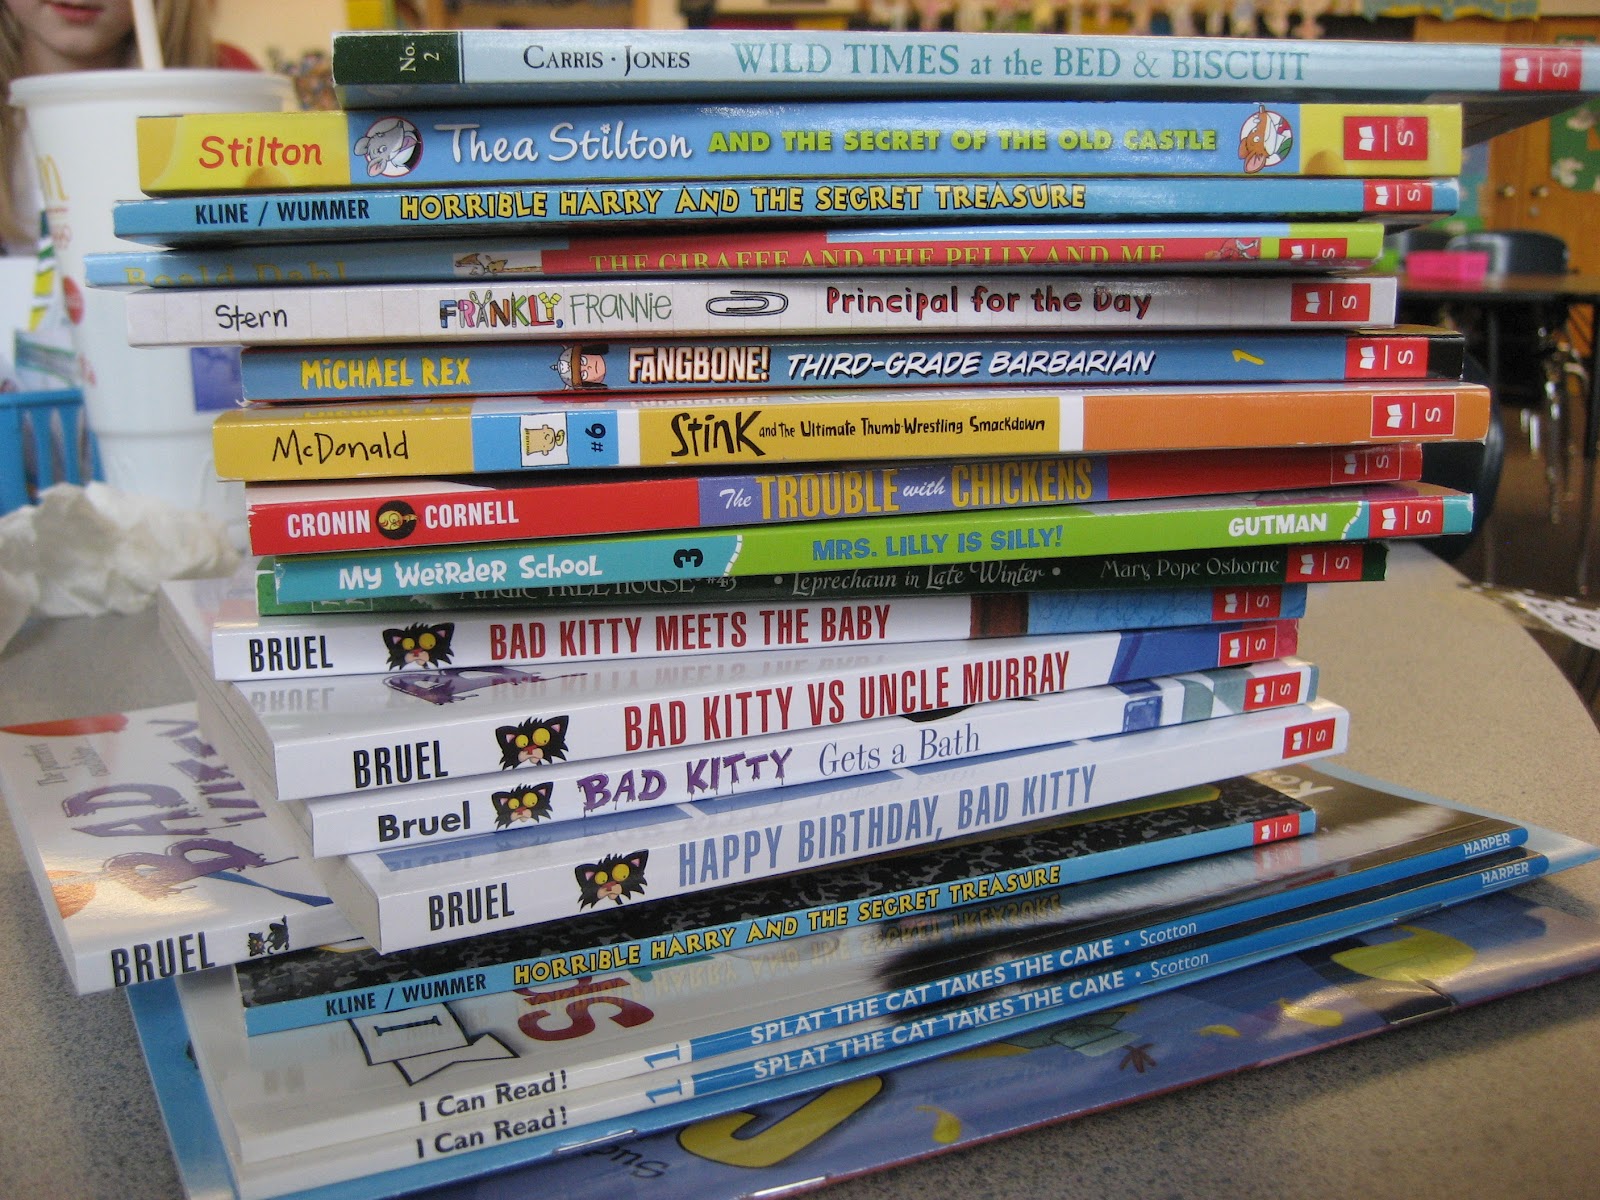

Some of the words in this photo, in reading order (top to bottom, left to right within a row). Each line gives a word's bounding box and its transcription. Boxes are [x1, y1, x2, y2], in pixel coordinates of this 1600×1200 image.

[400, 41, 417, 72] No.
[423, 51, 440, 62] 2
[731, 42, 832, 74] WILD
[844, 43, 960, 76] TIMES
[970, 54, 993, 76] at
[1003, 47, 1043, 77] the
[1053, 46, 1121, 79] BED
[1133, 51, 1161, 79] &
[1172, 48, 1310, 81] BISCUIT
[199, 135, 322, 169] Stilton
[433, 122, 539, 164] Thea
[548, 119, 693, 162] Stilton
[707, 130, 777, 154] AND
[780, 129, 838, 152] THE
[843, 129, 941, 152] SECRET
[950, 129, 988, 152] OF
[996, 129, 1047, 151] THE
[1057, 129, 1113, 151] OLD
[1122, 129, 1217, 152] CASTLE
[195, 201, 249, 226] KLINE
[277, 199, 370, 222] WUMMER
[401, 190, 548, 221] HORRIBLE
[558, 187, 663, 218] HARRY
[675, 185, 740, 217] AND
[751, 185, 803, 213] THE
[815, 182, 924, 213] SECRET
[934, 181, 1087, 210] TREASURE
[589, 254, 649, 272] THE
[657, 250, 790, 271] GIRAFFE
[801, 249, 865, 268] AND
[872, 247, 935, 266] THE
[1046, 245, 1111, 263] AND
[1120, 245, 1166, 262] ME
[215, 304, 289, 332] Stern
[826, 286, 960, 321] Principal
[971, 284, 1021, 313] for
[1030, 284, 1083, 312] the
[1093, 285, 1153, 320] Day
[421, 356, 472, 388] REX
[628, 345, 771, 383] FANGBONE!
[787, 351, 981, 381] THIRD-GRADE
[987, 350, 1157, 378] BARBARIAN
[585, 422, 608, 453] #6
[758, 422, 777, 438] and
[778, 421, 796, 438] The
[800, 420, 857, 438] Ultimate
[861, 416, 963, 437] Thumb-Wrestling
[272, 429, 410, 466] McDonald
[719, 487, 752, 510] The
[754, 467, 901, 521] TROUBLE
[902, 474, 947, 498] with
[950, 457, 1093, 508] CHICKENS
[287, 508, 372, 539] CRONIN
[423, 500, 521, 530] CORNELL
[1228, 512, 1328, 538] GUTMAN
[672, 547, 705, 570] 3
[812, 537, 878, 562] MRS.
[886, 532, 949, 558] LILLY
[958, 530, 983, 554] IS
[990, 524, 1064, 551] SILLY!
[339, 564, 383, 591] My
[792, 572, 898, 597] Leprechaun
[904, 570, 920, 588] in
[926, 565, 966, 591] Late
[970, 561, 1045, 587] Winter
[1100, 558, 1151, 581] Mary
[1156, 557, 1201, 580] Pope
[1206, 557, 1281, 576] Osborne
[490, 621, 548, 661] BAD
[559, 616, 643, 657] KITTY
[655, 610, 748, 653] MEETS
[762, 607, 810, 646] THE
[820, 604, 892, 642] BABY
[249, 635, 334, 673] BRUEL
[624, 702, 688, 751] BAD
[703, 685, 793, 741] KITTY
[807, 679, 846, 727] VS
[858, 666, 950, 720] UNCLE
[961, 650, 1070, 705] MURRAY
[353, 740, 449, 789] BRUEL
[576, 769, 668, 815] BAD
[686, 747, 794, 796] KITTY
[818, 741, 882, 777] Gets
[891, 744, 908, 765] a
[918, 722, 982, 762] Bath
[378, 800, 472, 843] Bruel
[678, 825, 783, 888] HAPPY
[798, 794, 943, 863] BIRTHDAY,
[957, 783, 1010, 830] BAD
[1021, 764, 1098, 817] KITTY
[1463, 832, 1511, 856] HARPER
[1480, 861, 1530, 885] HARPER
[428, 882, 515, 932] BRUEL
[513, 943, 642, 985] HORRIBLE
[651, 927, 738, 960] HARRY
[746, 915, 799, 945] AND
[807, 905, 850, 931] THE
[857, 888, 940, 921] SECRET
[949, 865, 1062, 905] TREASURE
[111, 931, 217, 989] BRUEL
[326, 993, 377, 1018] KLINE
[401, 972, 488, 1004] WUMMER
[751, 1010, 823, 1045] SPLAT
[834, 999, 881, 1029] THE
[885, 987, 931, 1017] CAT
[935, 967, 1006, 1003] TAKES
[1009, 956, 1056, 983] THE
[1059, 940, 1115, 970] CAKE
[1138, 919, 1198, 947] Scotton
[753, 1044, 829, 1080] SPLAT
[839, 1033, 886, 1060] THE
[890, 1018, 937, 1047] CAT
[941, 1000, 1015, 1035] TAKES
[1019, 987, 1065, 1013] THE
[1068, 969, 1125, 1000] CAKE
[1150, 951, 1210, 979] Scotton
[419, 1100, 427, 1122] I
[437, 1093, 486, 1118] Can
[495, 1069, 568, 1104] Read!
[417, 1138, 425, 1159] I
[435, 1129, 485, 1154] Can
[495, 1105, 568, 1142] Read!
